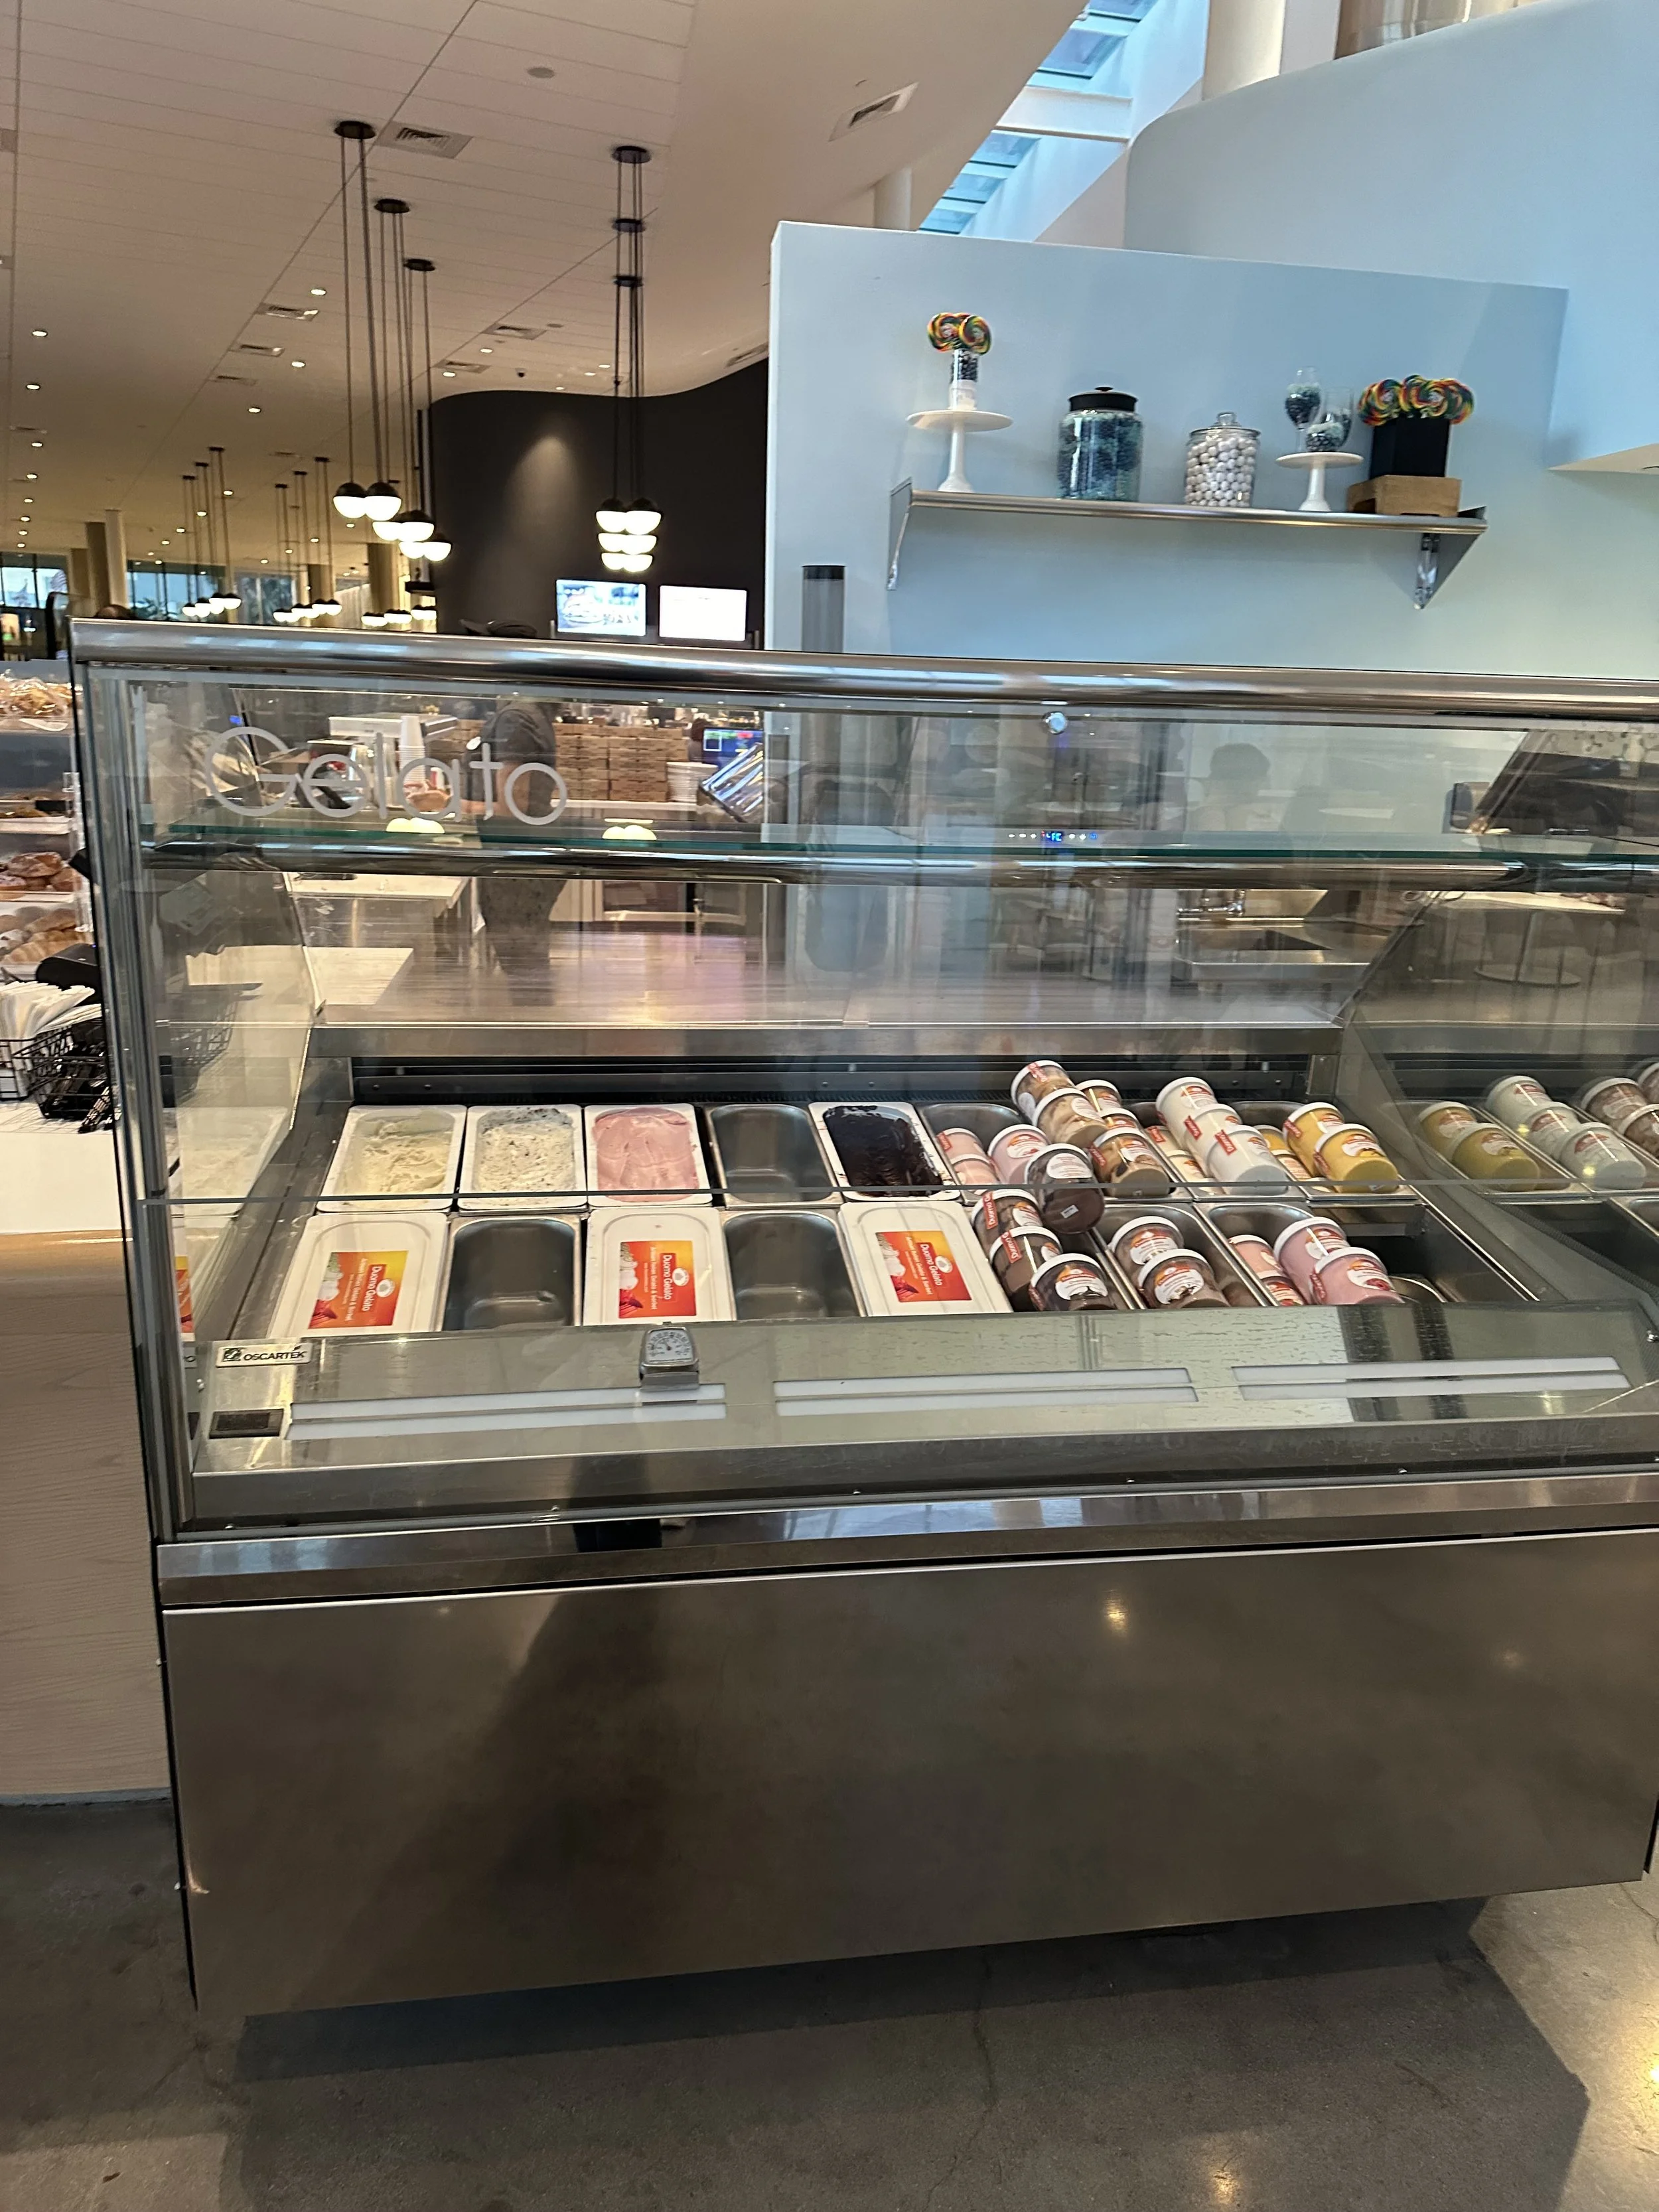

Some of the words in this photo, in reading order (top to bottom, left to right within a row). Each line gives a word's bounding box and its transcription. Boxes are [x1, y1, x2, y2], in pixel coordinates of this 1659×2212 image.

[206, 727, 567, 826] Gelato
[663, 1254, 672, 1278] Duomo
[920, 1244, 934, 1265] Duomo
[930, 1266, 943, 1286] Gelato
[368, 1266, 382, 1289] Duomo
[663, 1278, 674, 1299] Gelato
[362, 1290, 376, 1311] Gelato
[244, 1349, 308, 1361] OSCARTEK
